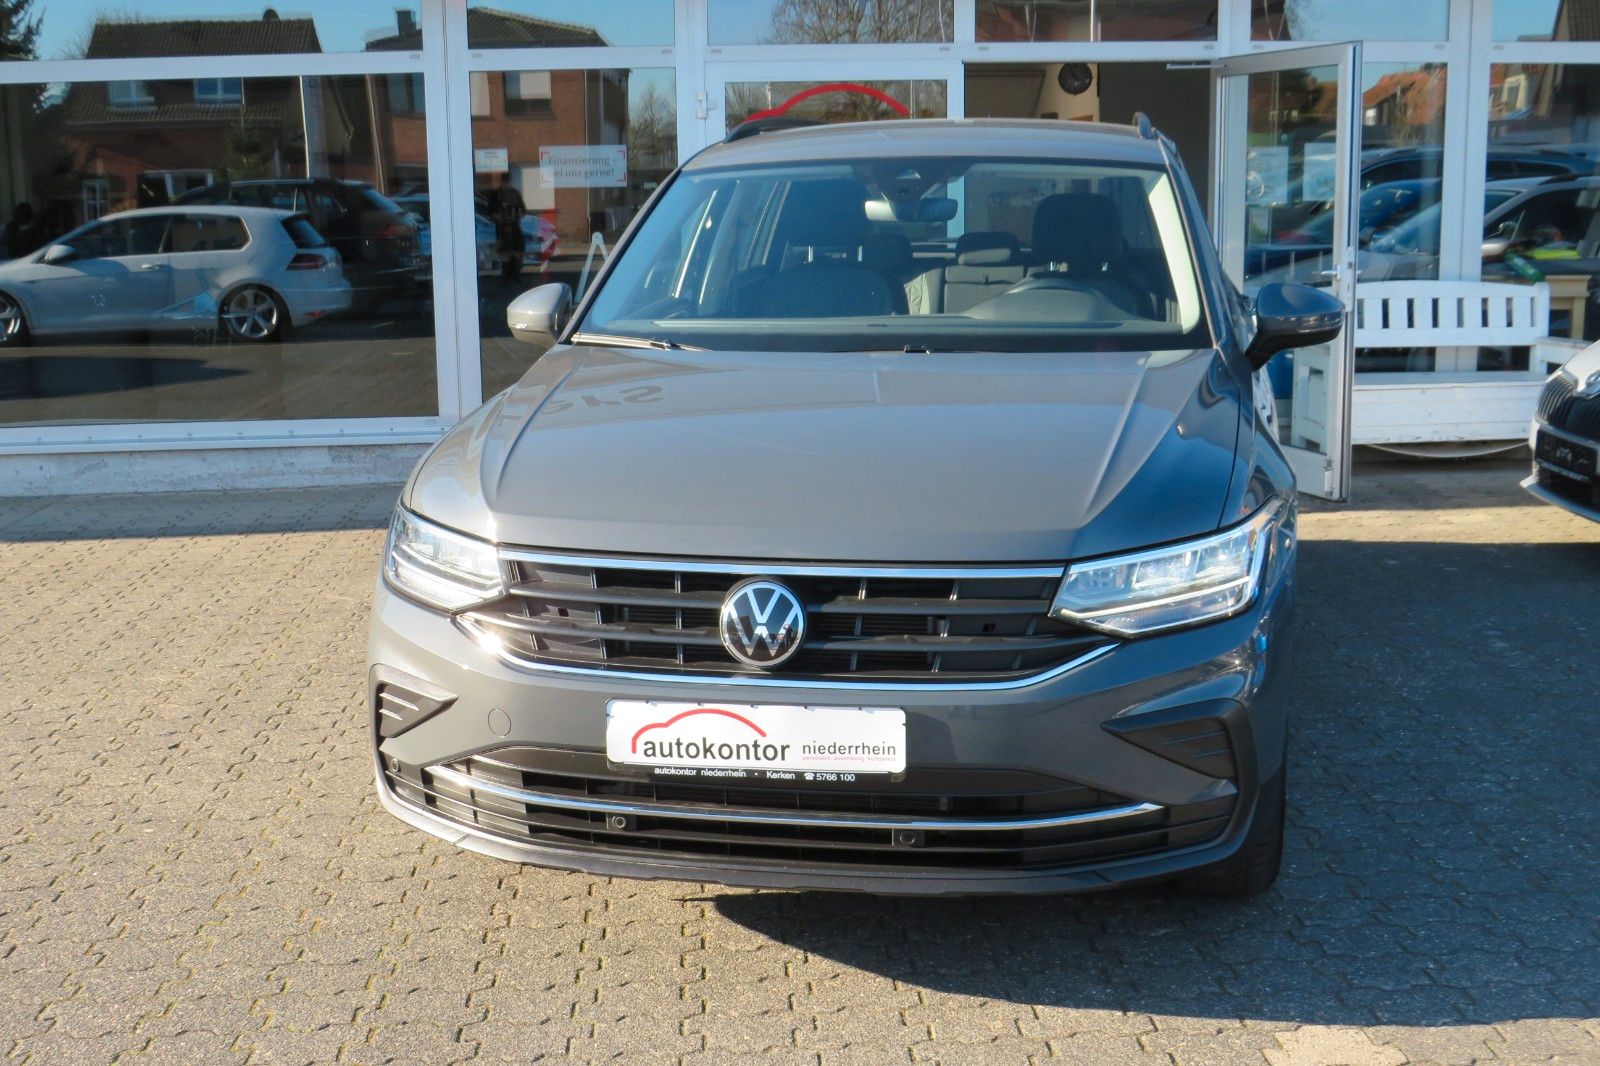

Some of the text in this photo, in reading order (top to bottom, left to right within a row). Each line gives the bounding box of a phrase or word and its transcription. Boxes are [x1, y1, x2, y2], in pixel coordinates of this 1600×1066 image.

[643, 737, 896, 761] autokontor niederrhein
[654, 767, 697, 776] autokontor
[701, 768, 747, 777] niederrhein
[766, 771, 796, 780] Kerken
[816, 773, 838, 781] 5766
